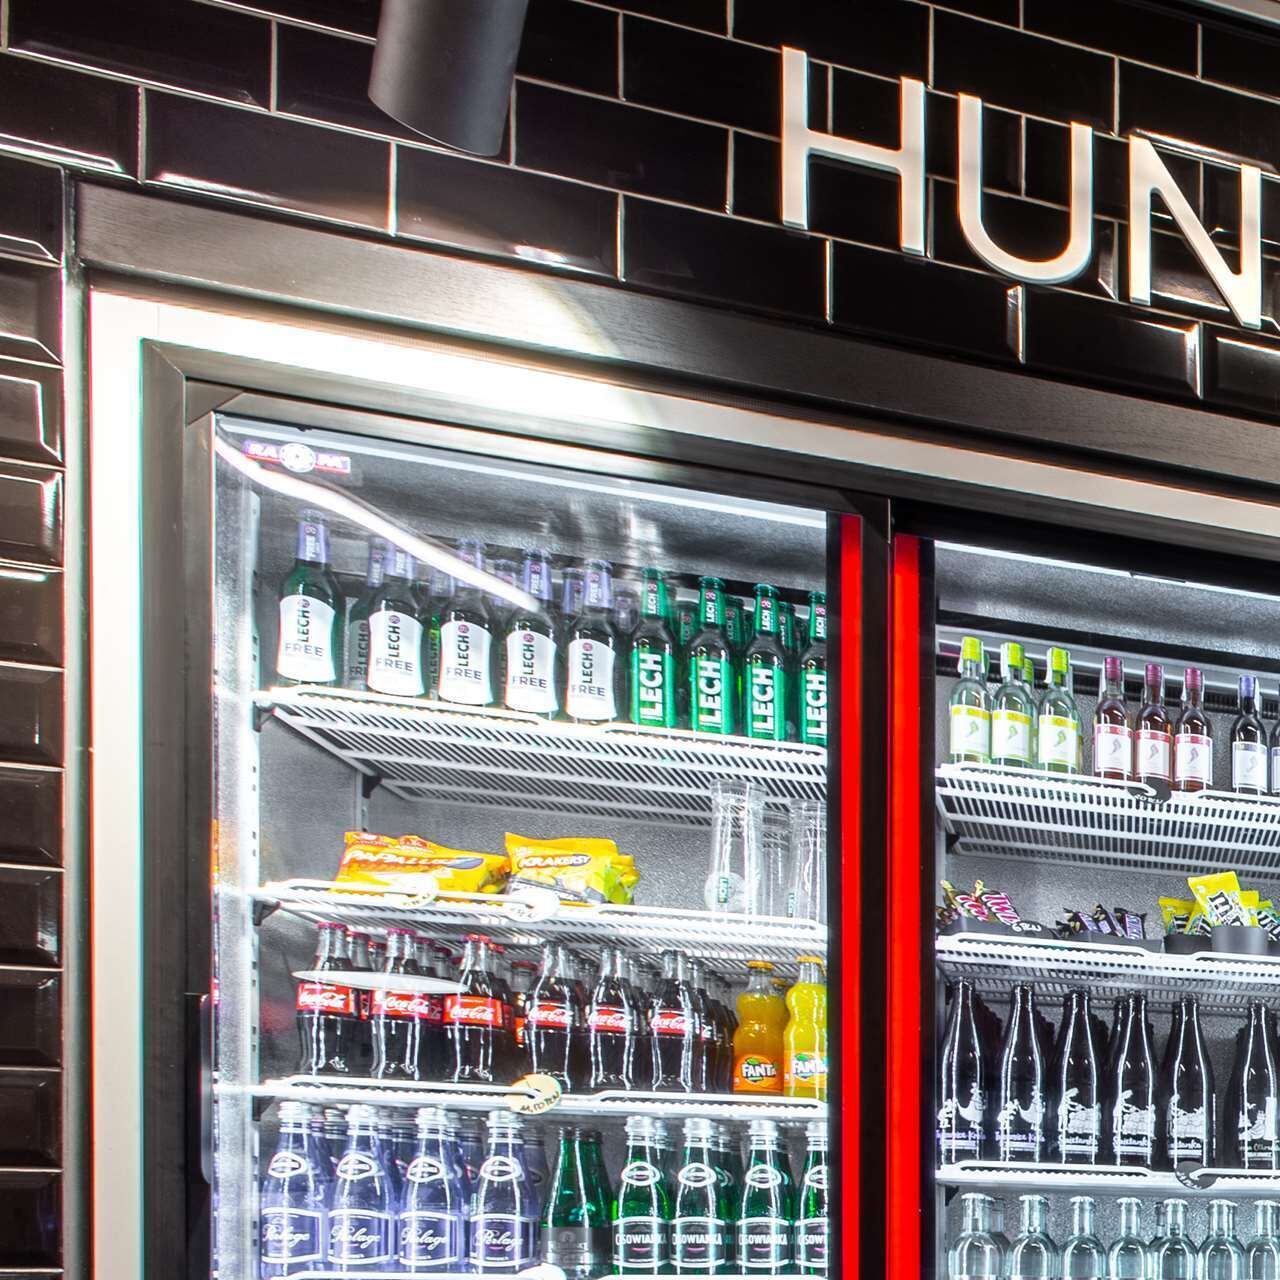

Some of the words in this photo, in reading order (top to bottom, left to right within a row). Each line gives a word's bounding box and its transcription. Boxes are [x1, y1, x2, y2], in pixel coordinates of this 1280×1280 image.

[298, 609, 311, 643] LECH
[388, 626, 400, 658] LECH
[285, 643, 324, 657] FREE
[375, 658, 414, 672] FREE
[458, 635, 470, 667] LECH
[523, 643, 535, 676] LECH
[446, 667, 482, 680] FREE
[512, 675, 548, 689] FREE
[582, 652, 594, 684] LECH
[571, 684, 606, 697] FREE
[640, 654, 663, 719] LECH
[699, 661, 722, 725] LECH
[753, 668, 774, 731] LECH
[806, 674, 827, 736] LECH
[742, 1063, 776, 1078] FANTA
